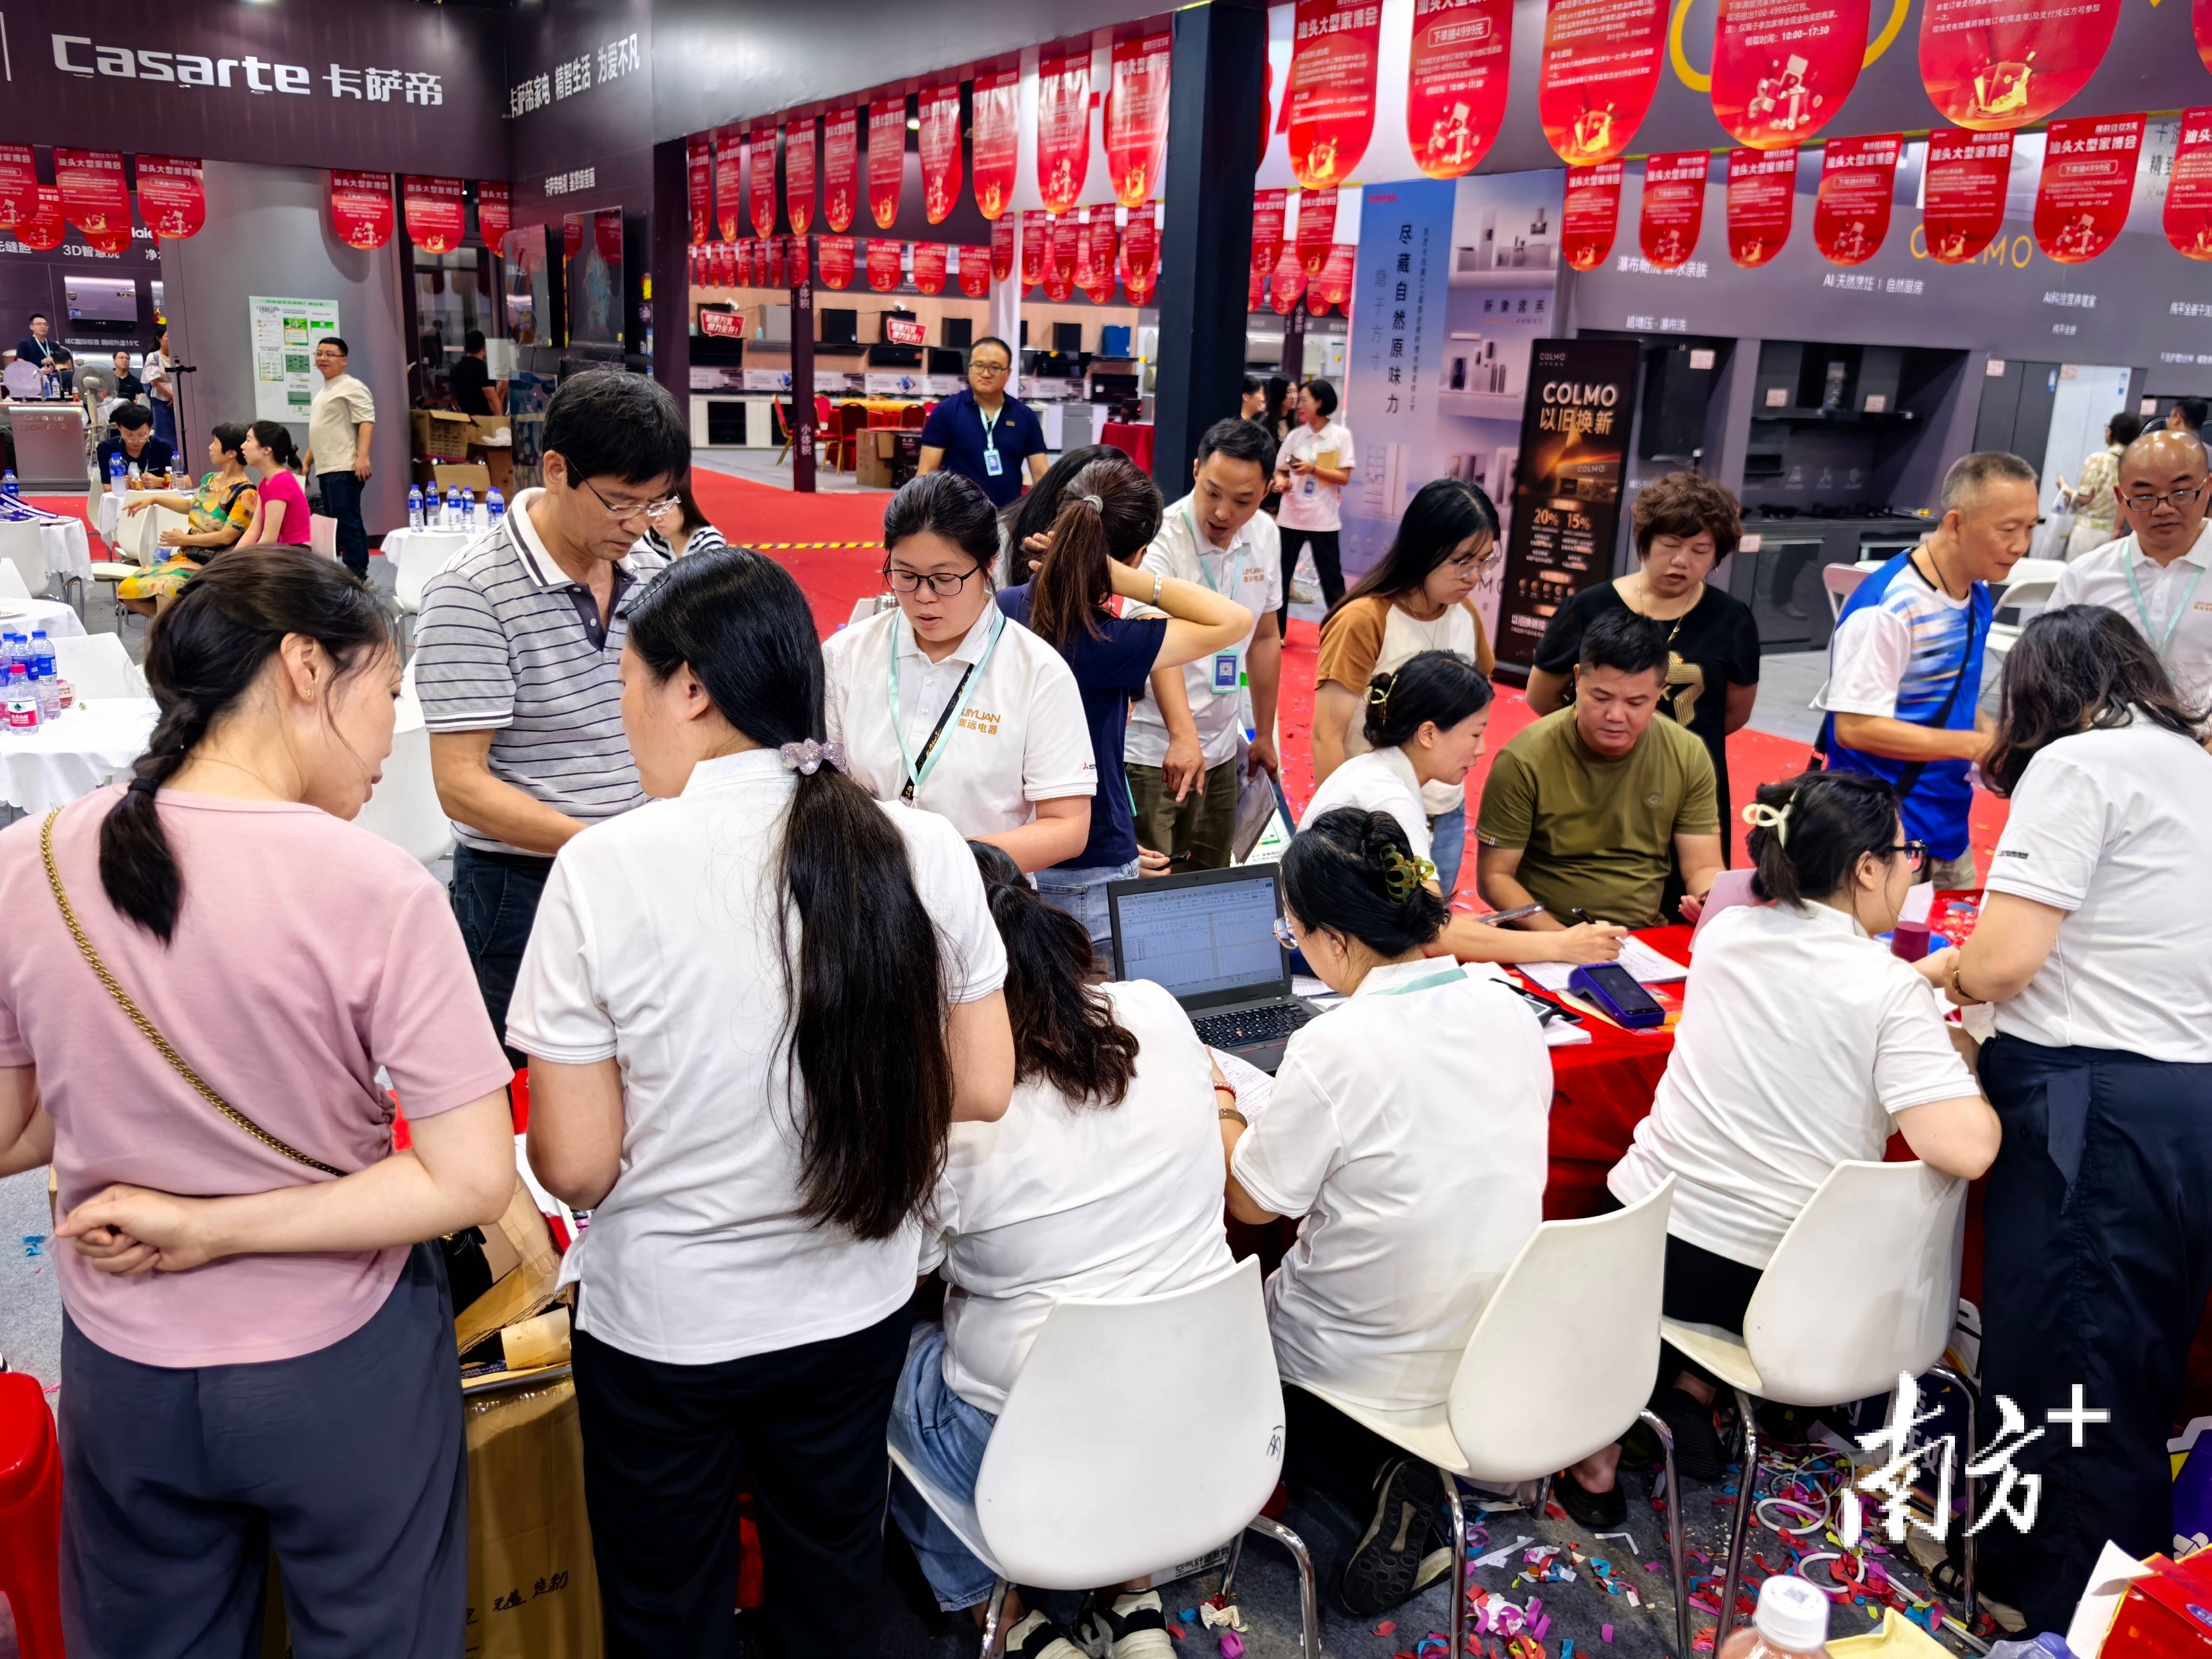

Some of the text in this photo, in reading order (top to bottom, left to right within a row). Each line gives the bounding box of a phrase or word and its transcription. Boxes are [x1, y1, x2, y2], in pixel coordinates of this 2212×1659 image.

[1297, 6, 1378, 39] 汕头大型家博会
[51, 33, 311, 96] Casarte
[510, 33, 640, 118] 卡萨帝家电 精智生活 为爱不凡
[322, 63, 444, 106] 卡萨帝
[1930, 144, 2009, 161] 汕头大型家博会
[2049, 135, 2137, 155] 汕头大型家博会
[1730, 159, 1795, 177] 汕头大型家博会
[1826, 152, 1896, 169] 汕头大型家博会
[1910, 225, 2033, 268] CMO
[1386, 224, 1413, 413] 尽藏自然原味力
[1543, 381, 1617, 407] COLMO
[1540, 407, 1615, 435] 以旧换新
[1533, 508, 1591, 531] 20% 15%
[957, 718, 998, 735] 集远电器
